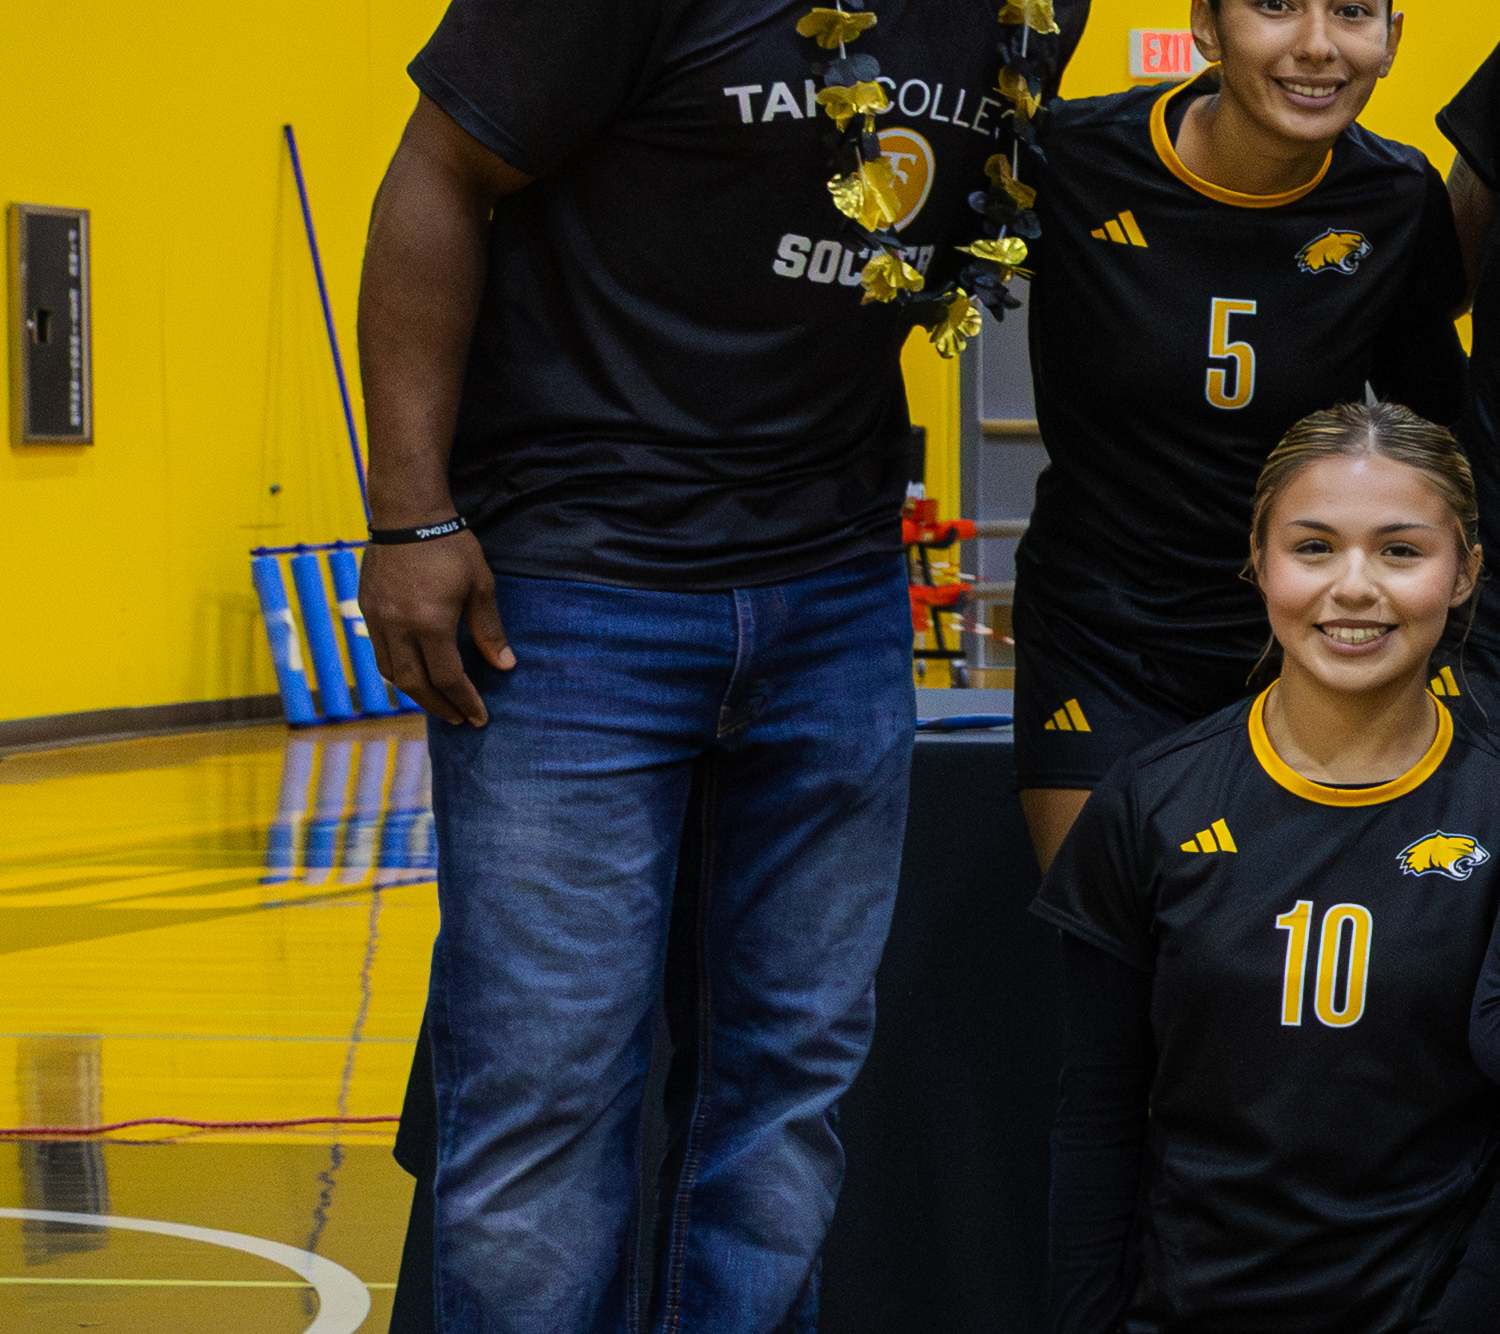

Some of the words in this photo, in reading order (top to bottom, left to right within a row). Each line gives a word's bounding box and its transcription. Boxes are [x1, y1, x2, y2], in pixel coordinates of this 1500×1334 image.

[1142, 32, 1194, 74] EXIT
[1205, 296, 1257, 410] 5
[1275, 899, 1374, 1029] 10
